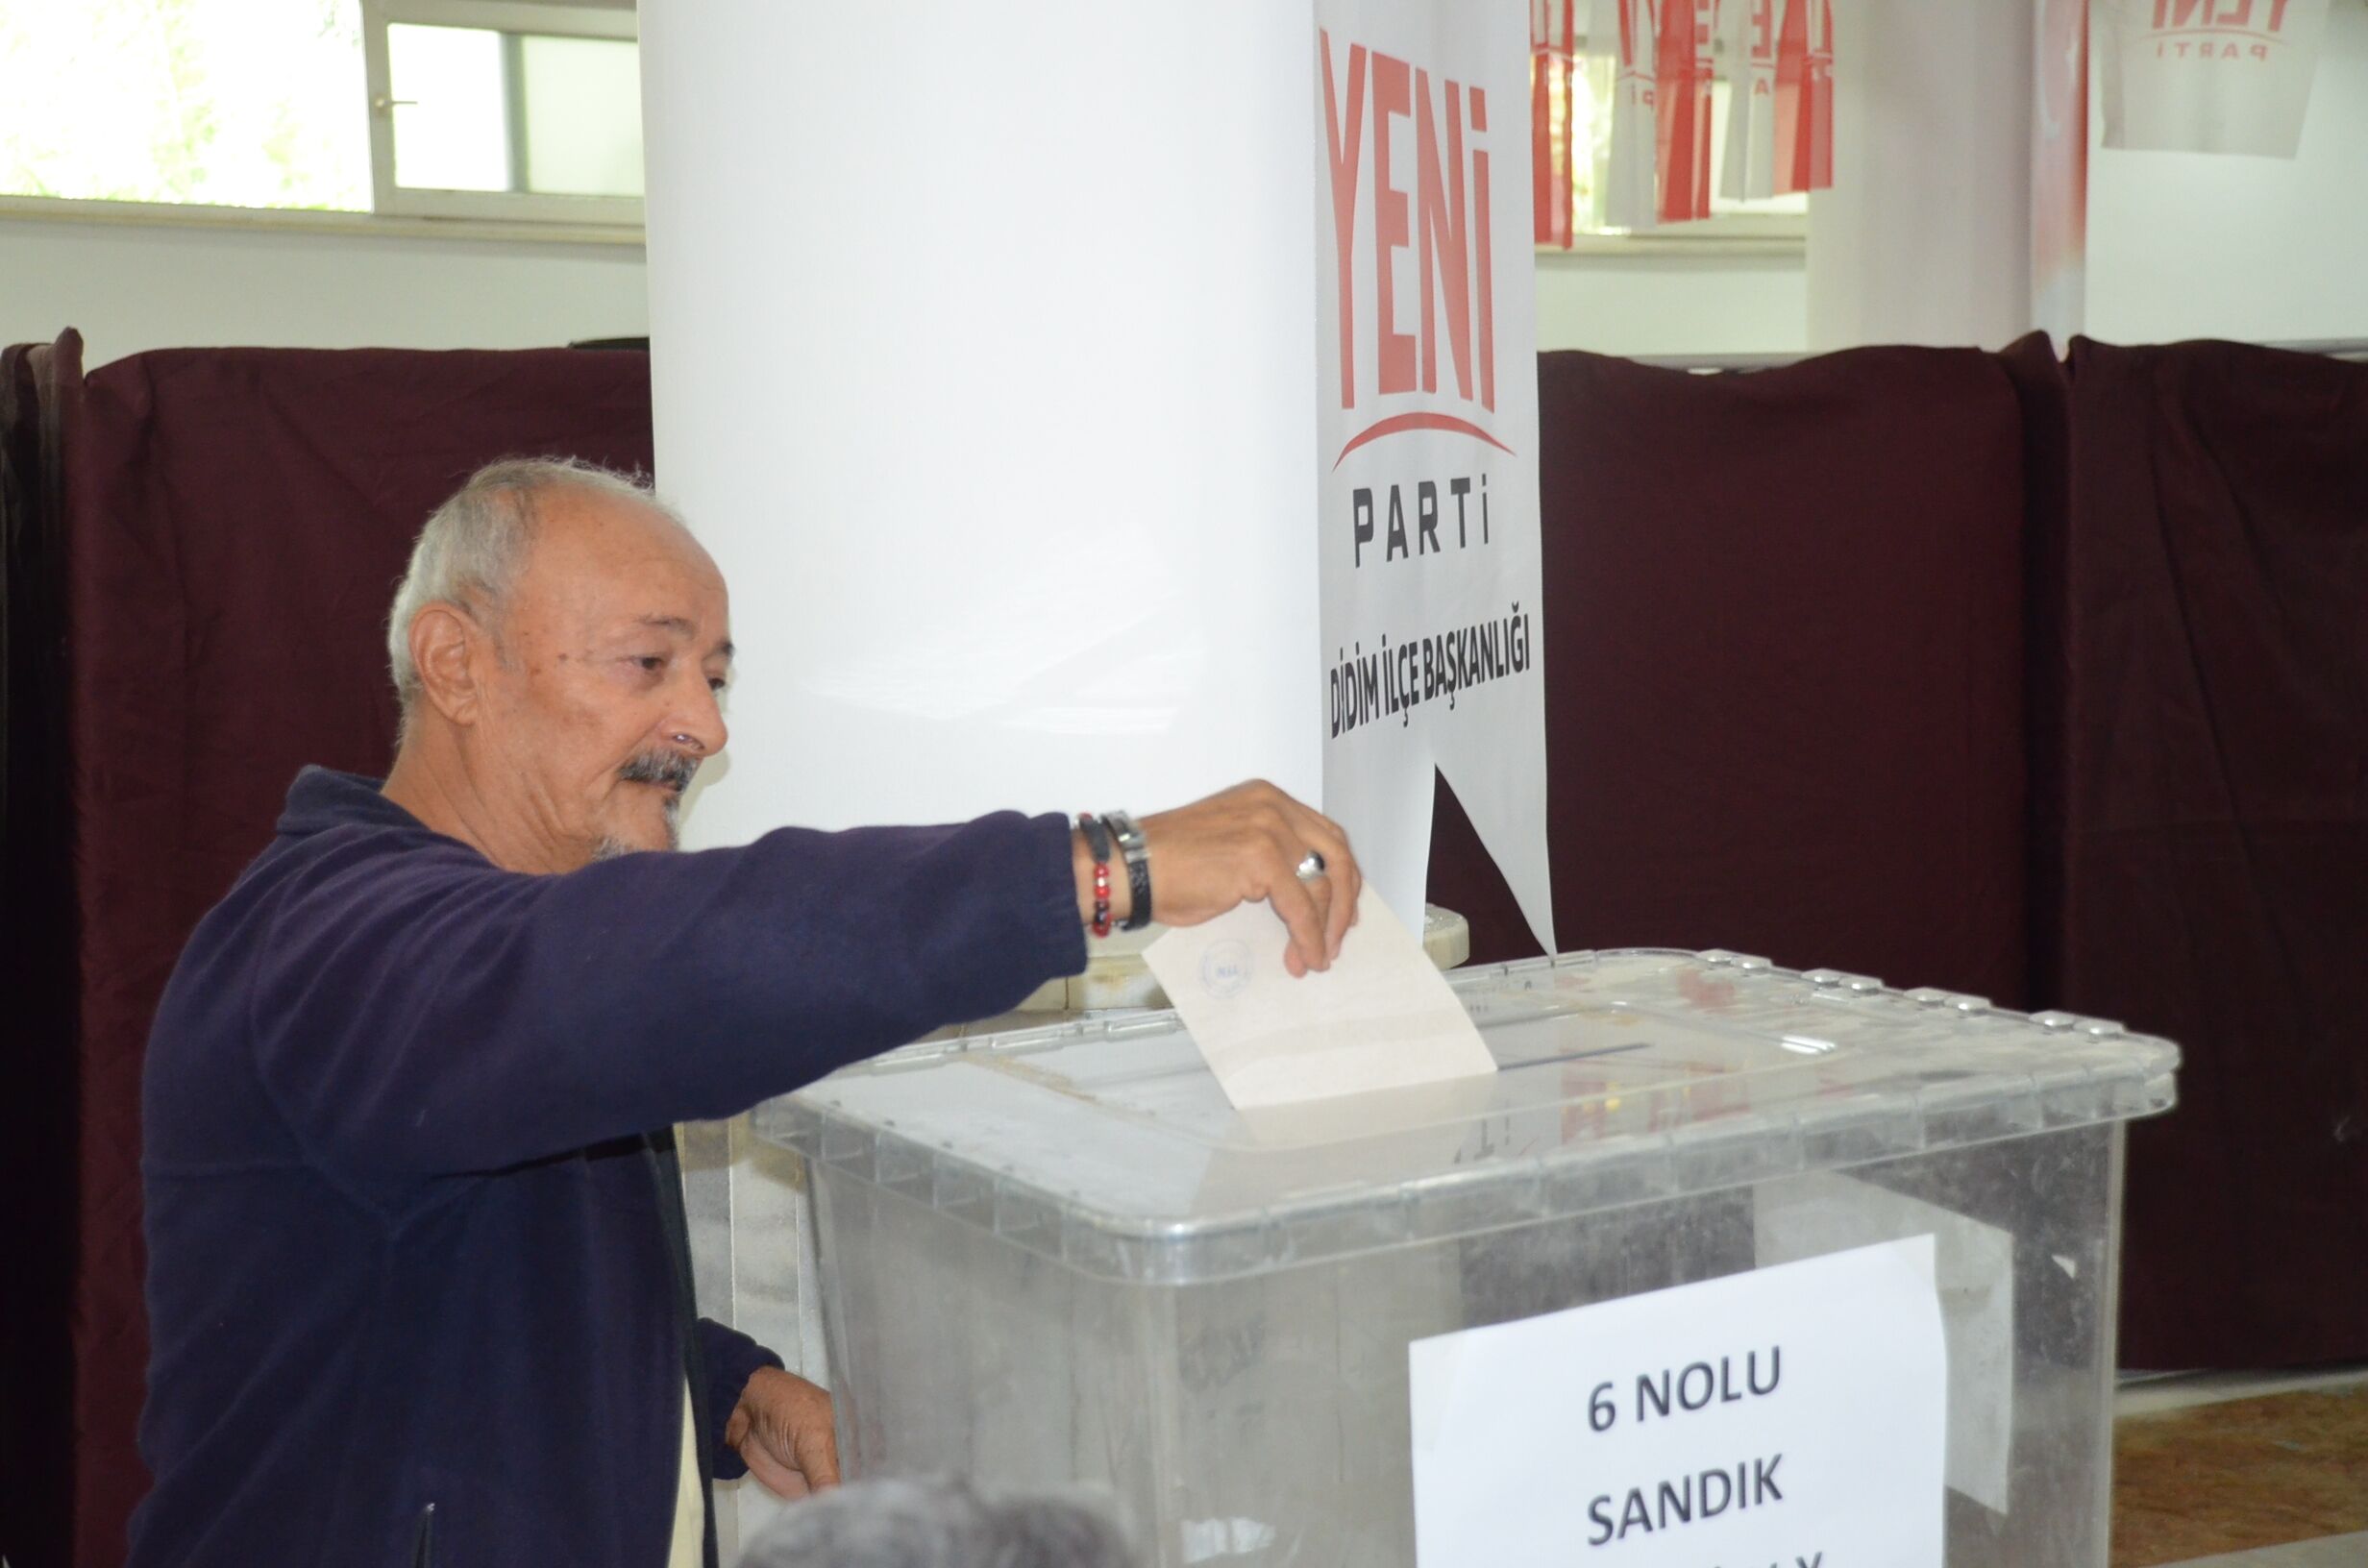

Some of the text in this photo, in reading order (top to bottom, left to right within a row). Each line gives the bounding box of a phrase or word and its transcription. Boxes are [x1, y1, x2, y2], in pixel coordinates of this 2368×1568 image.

[1330, 600, 1530, 739] DİDİM İLÇE BAŞKANLIĞI
[1588, 1346, 1781, 1432] 6 NOLU
[1588, 1454, 1784, 1546] SANDIK
